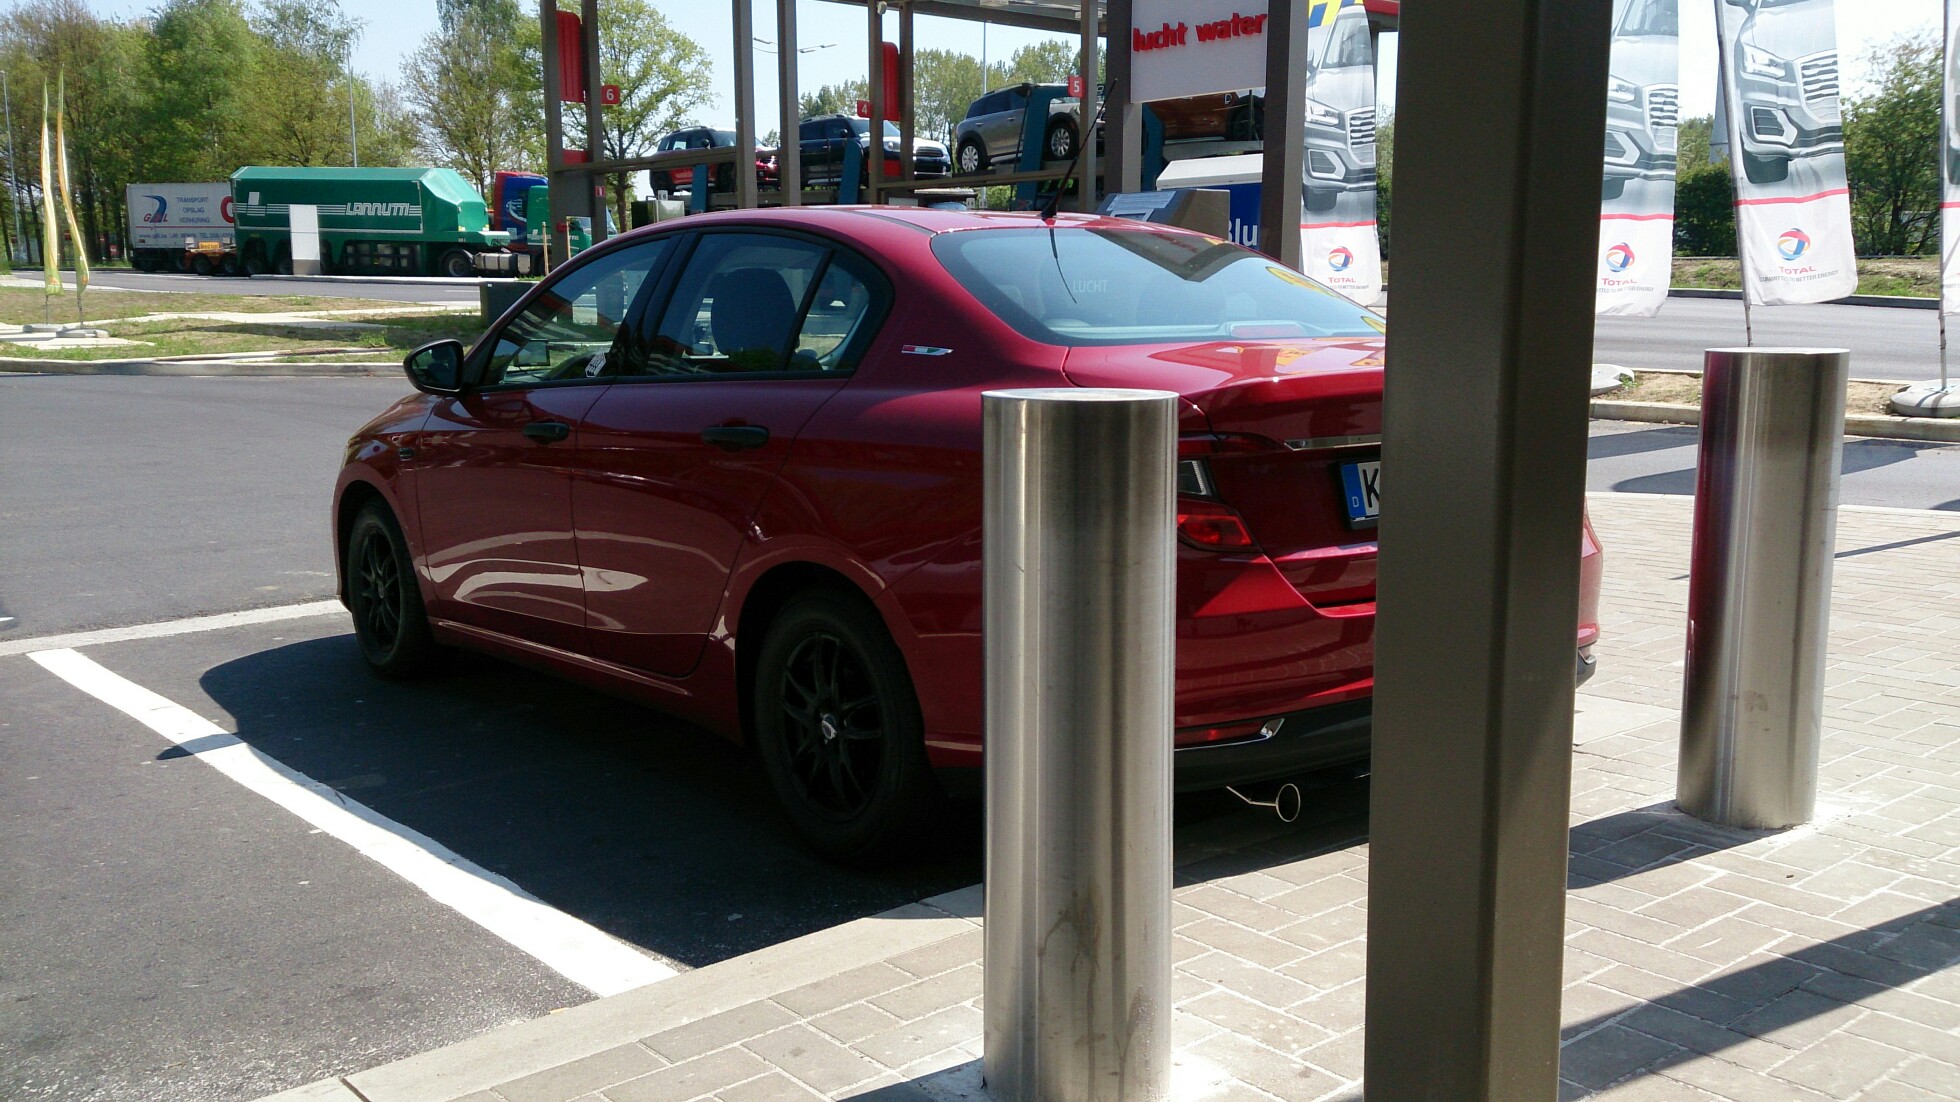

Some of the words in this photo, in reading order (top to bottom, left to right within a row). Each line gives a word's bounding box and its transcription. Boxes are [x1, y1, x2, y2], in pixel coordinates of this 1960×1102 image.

[1133, 21, 1188, 52] lucht
[1195, 12, 1267, 42] water
[1073, 81, 1081, 93] 5
[606, 88, 615, 101] 6
[861, 104, 869, 115] 4
[1779, 265, 1817, 275] TOTAL
[1072, 280, 1109, 293] LUCHT
[1601, 277, 1637, 286] TOTAL
[1352, 496, 1359, 508] D
[1362, 467, 1380, 508] K
